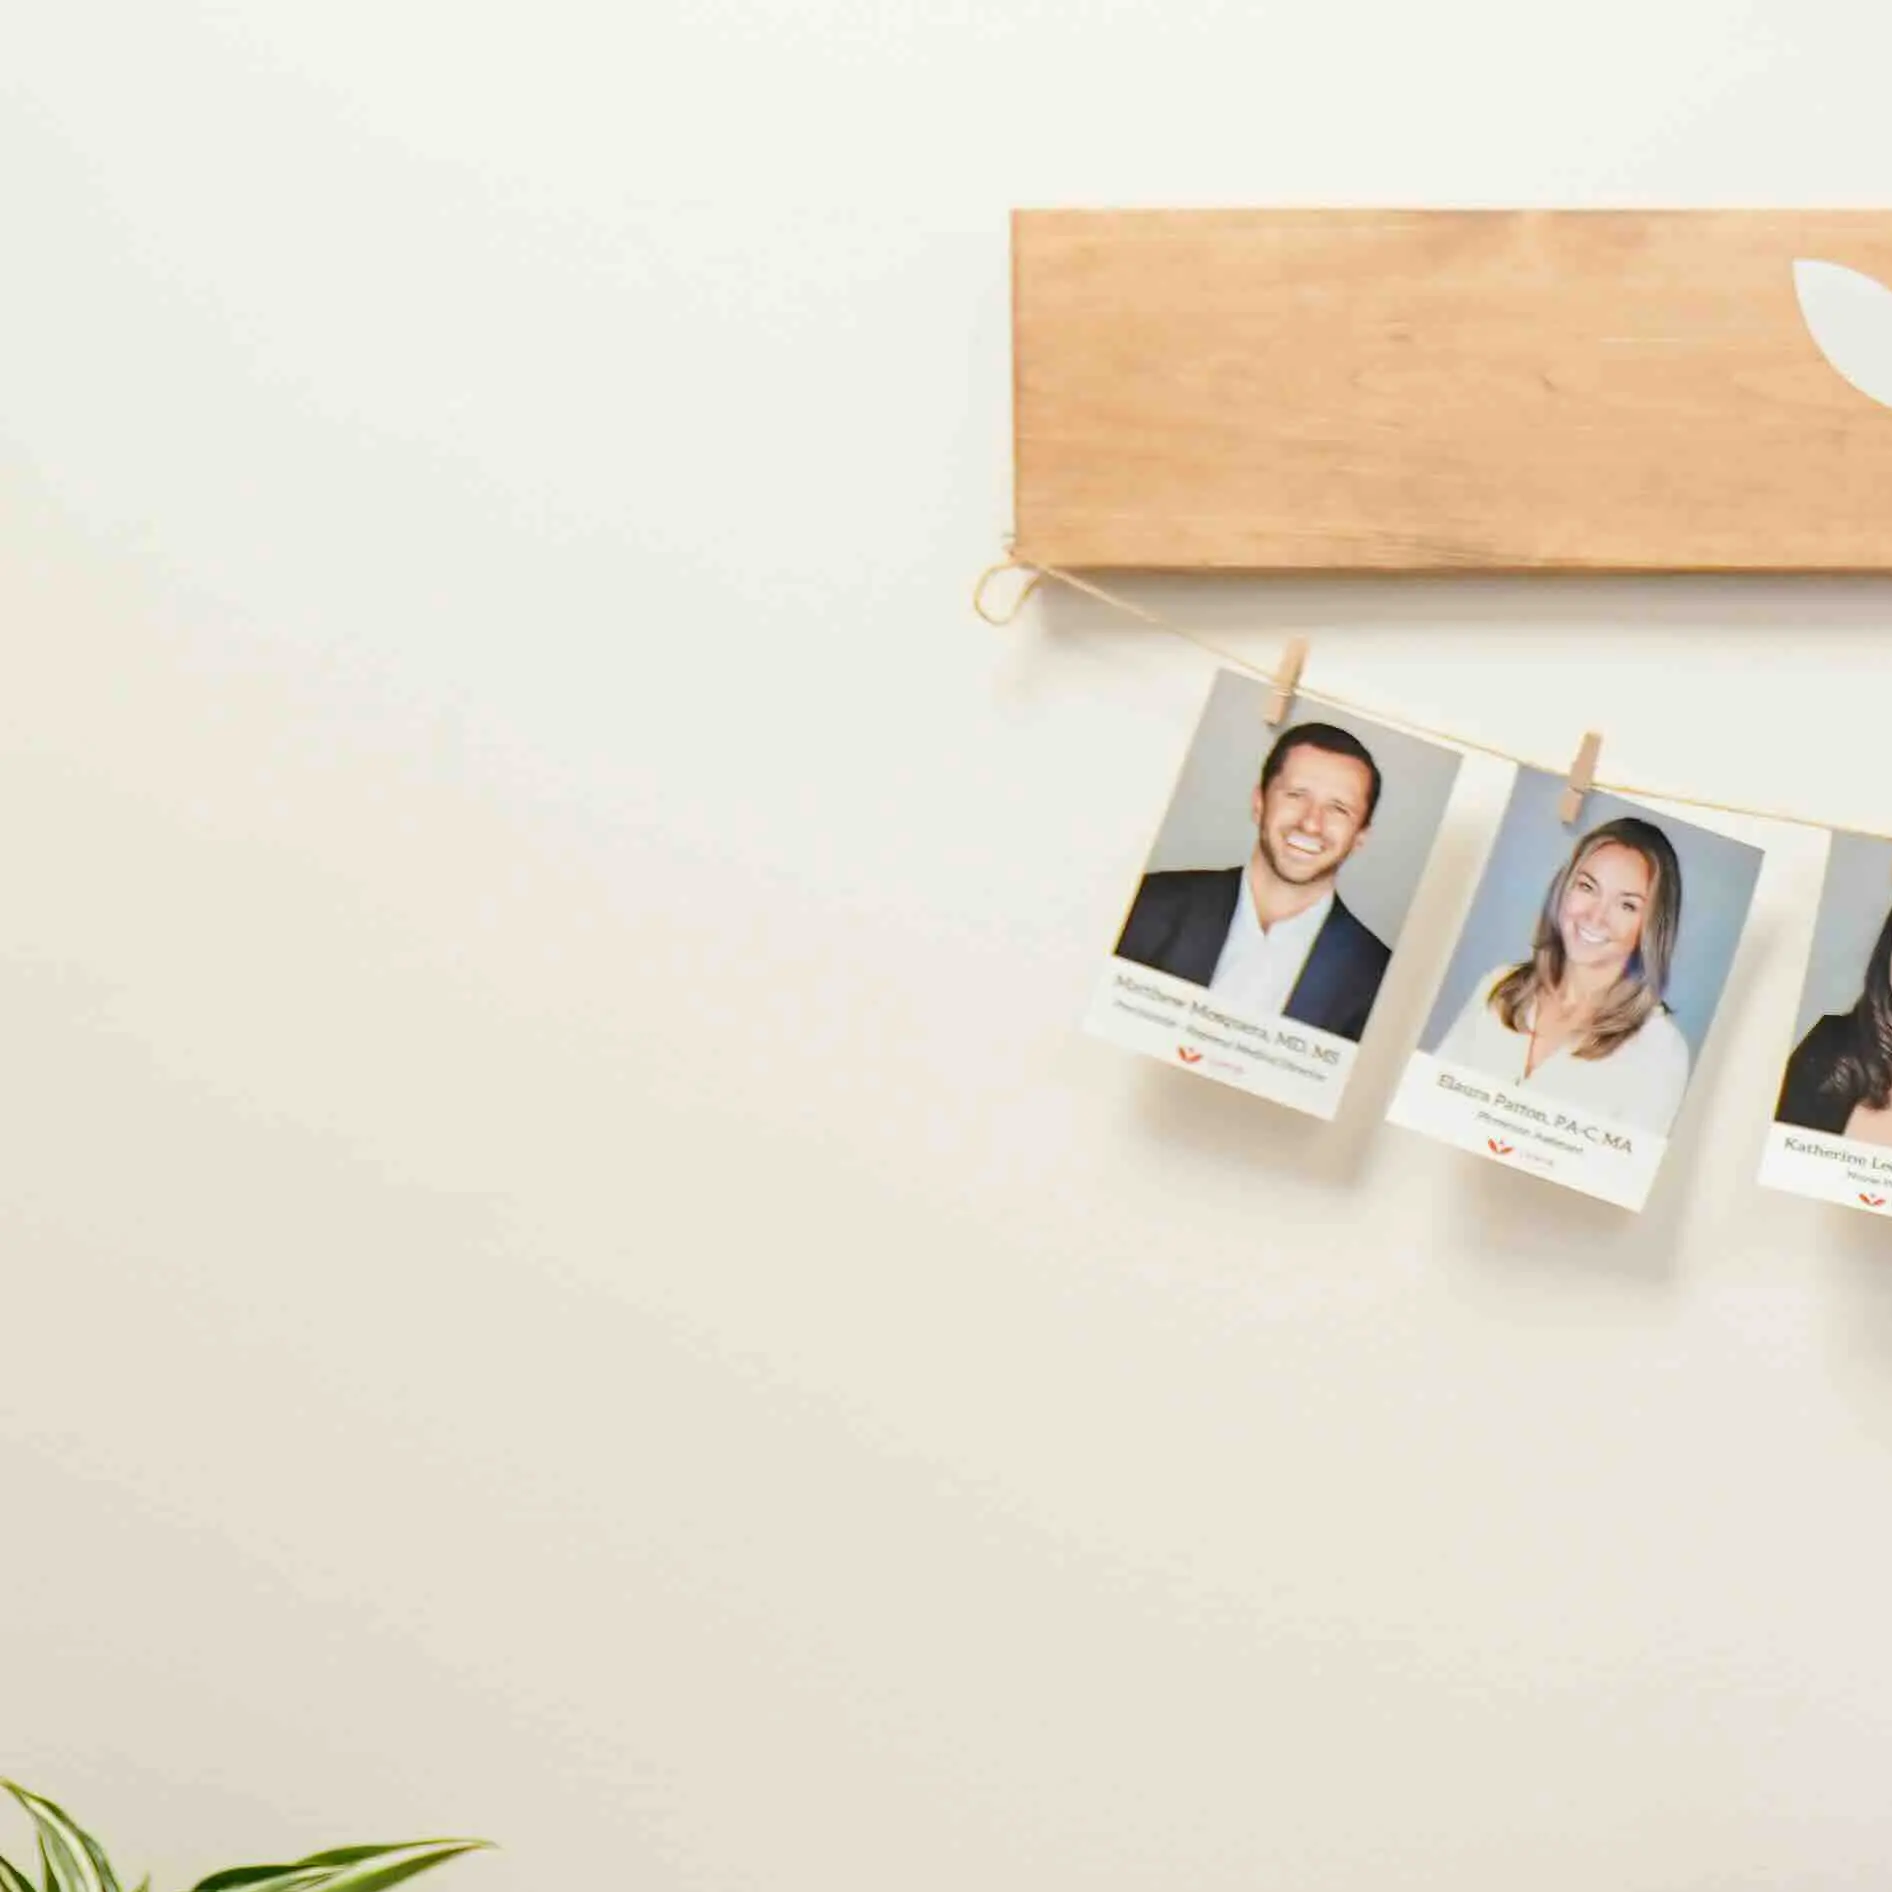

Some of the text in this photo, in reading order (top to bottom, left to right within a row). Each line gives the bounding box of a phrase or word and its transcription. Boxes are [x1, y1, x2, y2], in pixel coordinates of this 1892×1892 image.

[1312, 1043, 1341, 1065] MS
[1602, 1131, 1633, 1154] MA
[1784, 1136, 1867, 1169] Katherine
